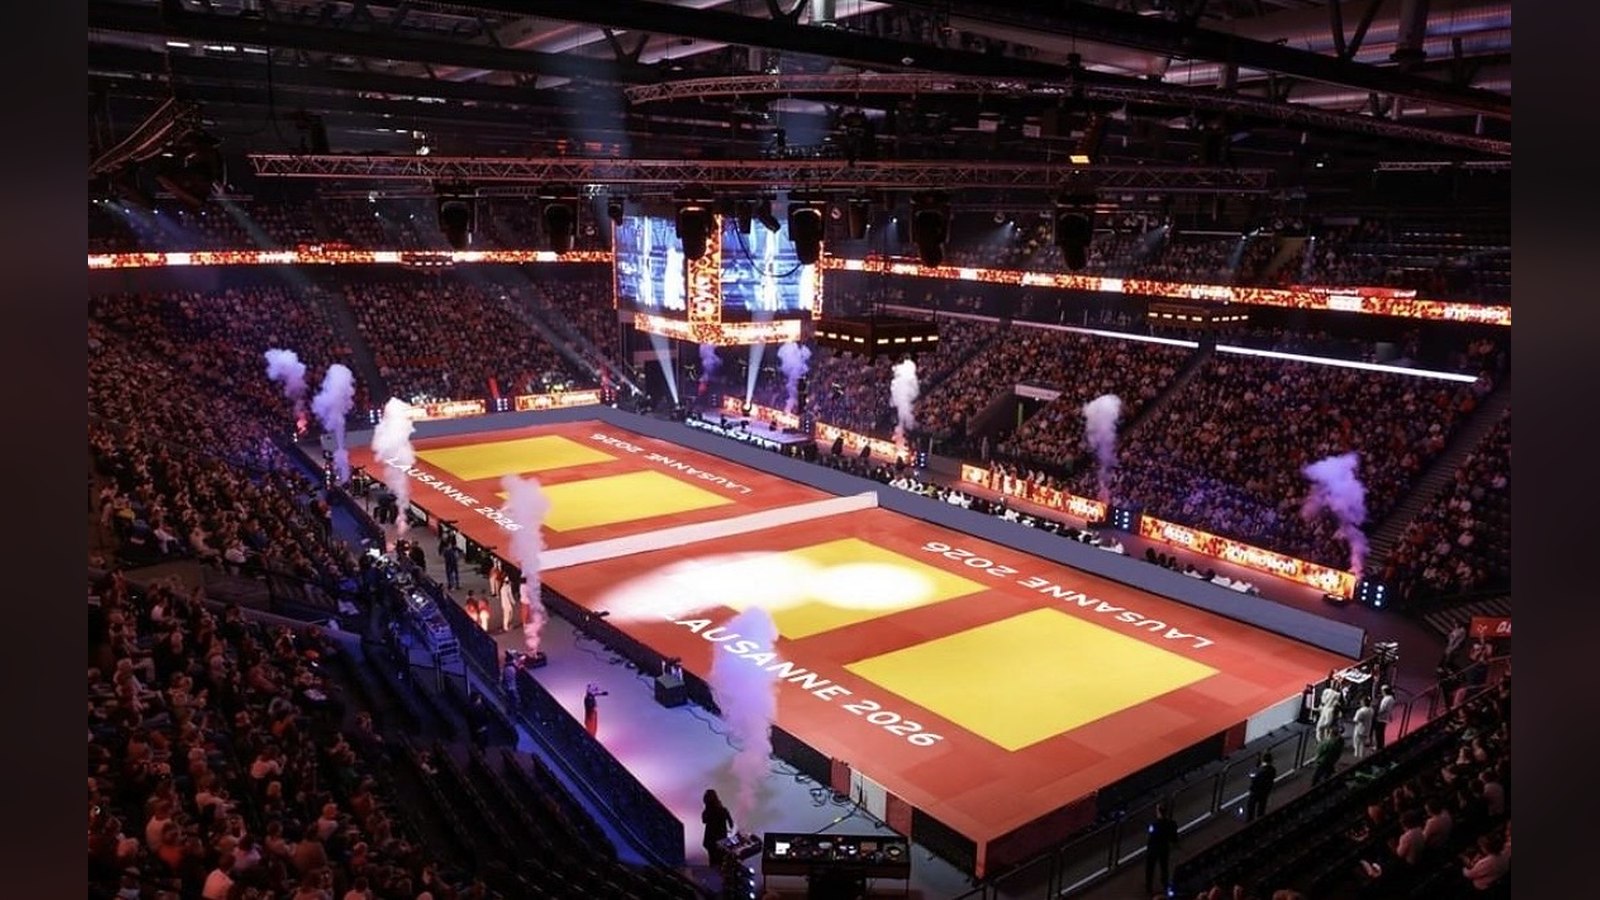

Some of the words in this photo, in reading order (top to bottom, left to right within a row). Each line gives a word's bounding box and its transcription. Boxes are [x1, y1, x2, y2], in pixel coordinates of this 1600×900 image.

[589, 433, 645, 454] 2026
[385, 457, 480, 507] LAUSANNE
[474, 506, 523, 531] 2026
[643, 451, 753, 495] LAUSANNE
[920, 540, 1019, 578] 2026
[1016, 575, 1216, 649] LAUSANNE
[841, 699, 944, 747] 2026
